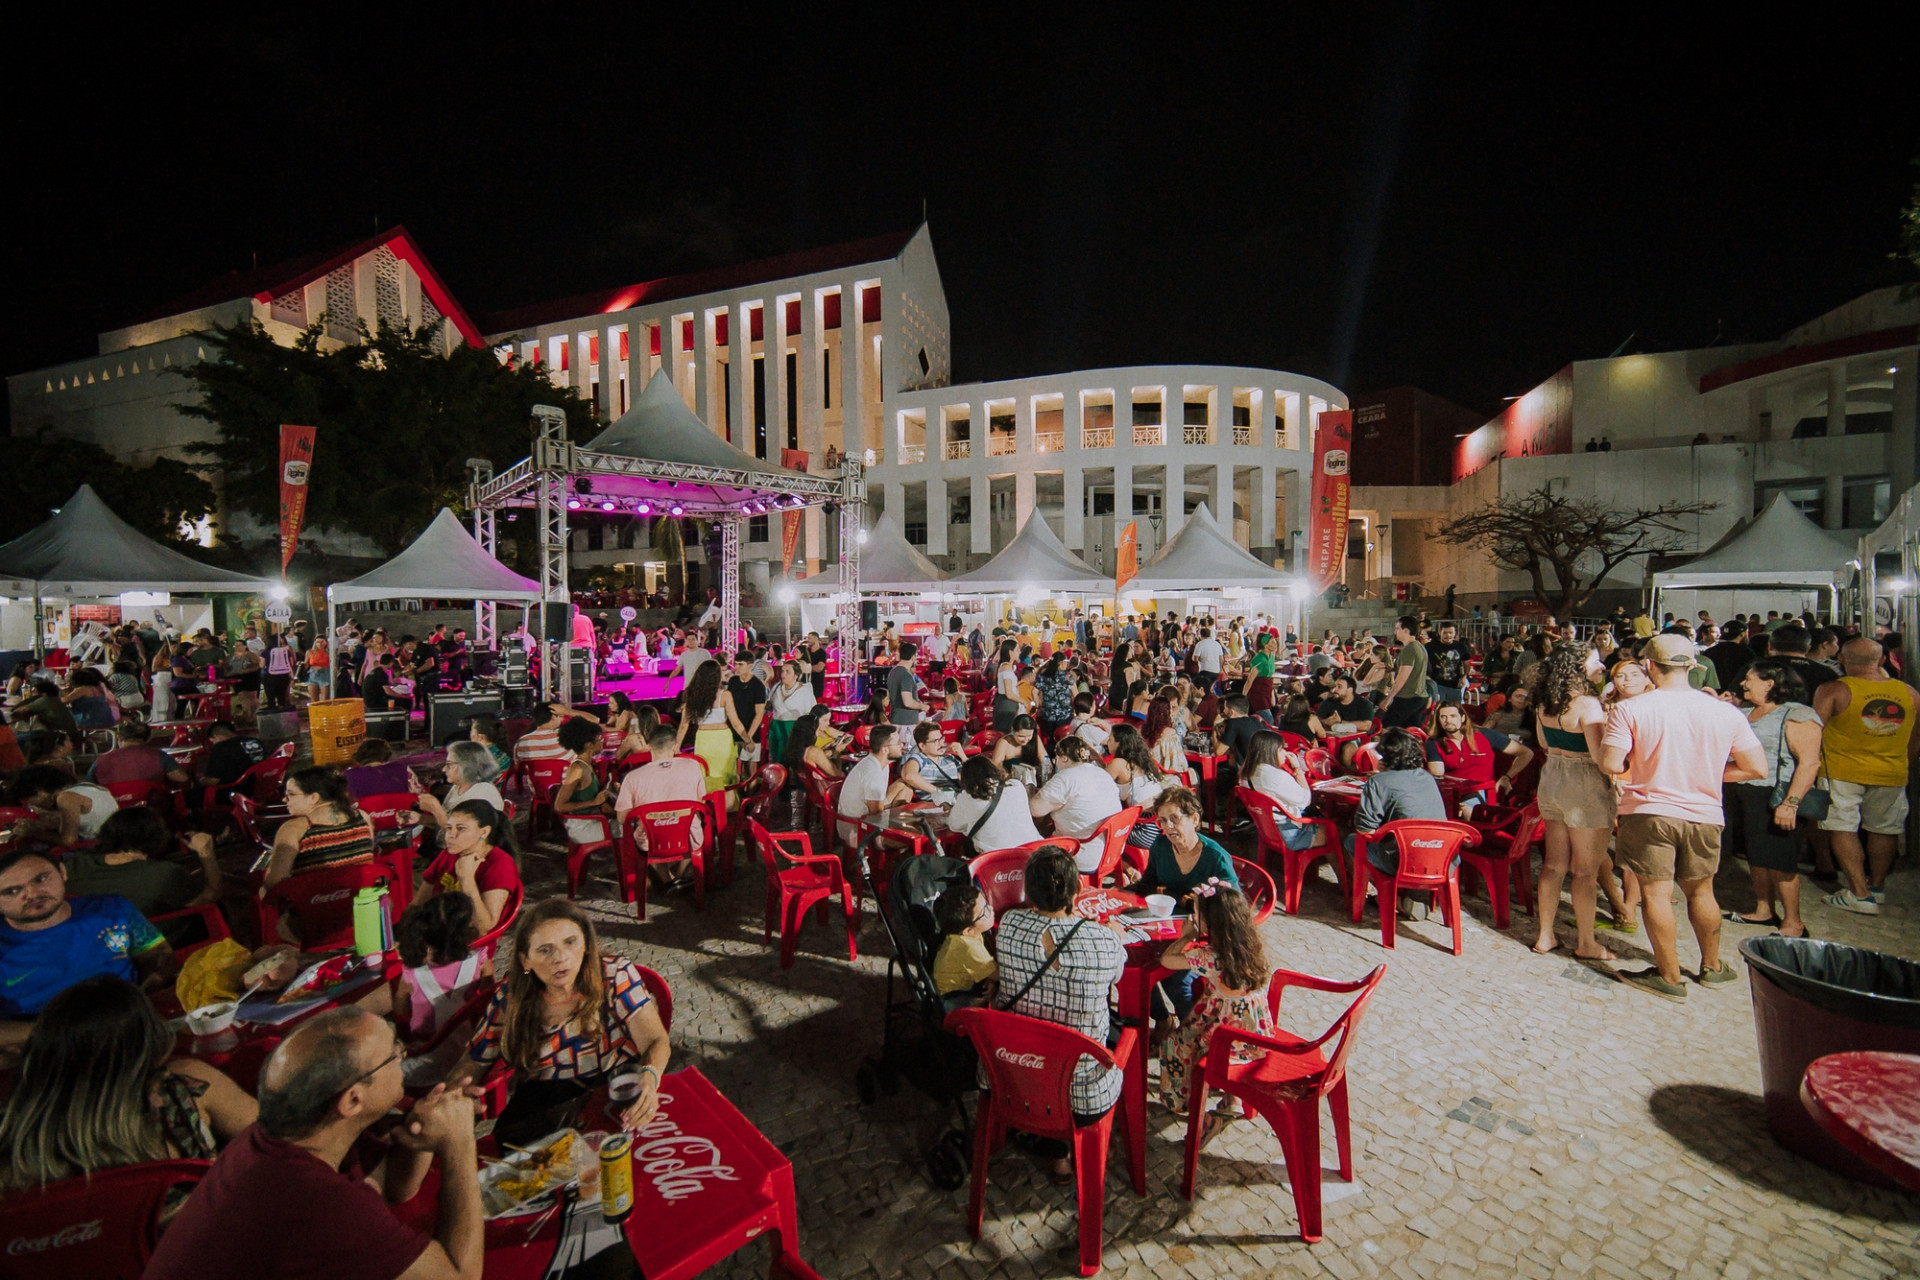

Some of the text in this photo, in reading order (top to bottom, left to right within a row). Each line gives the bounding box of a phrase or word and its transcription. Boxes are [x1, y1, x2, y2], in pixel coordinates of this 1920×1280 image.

[1320, 528, 1331, 576] PREPARE
[266, 608, 290, 618] CAIXA
[995, 1047, 1046, 1069] Coca-Cola
